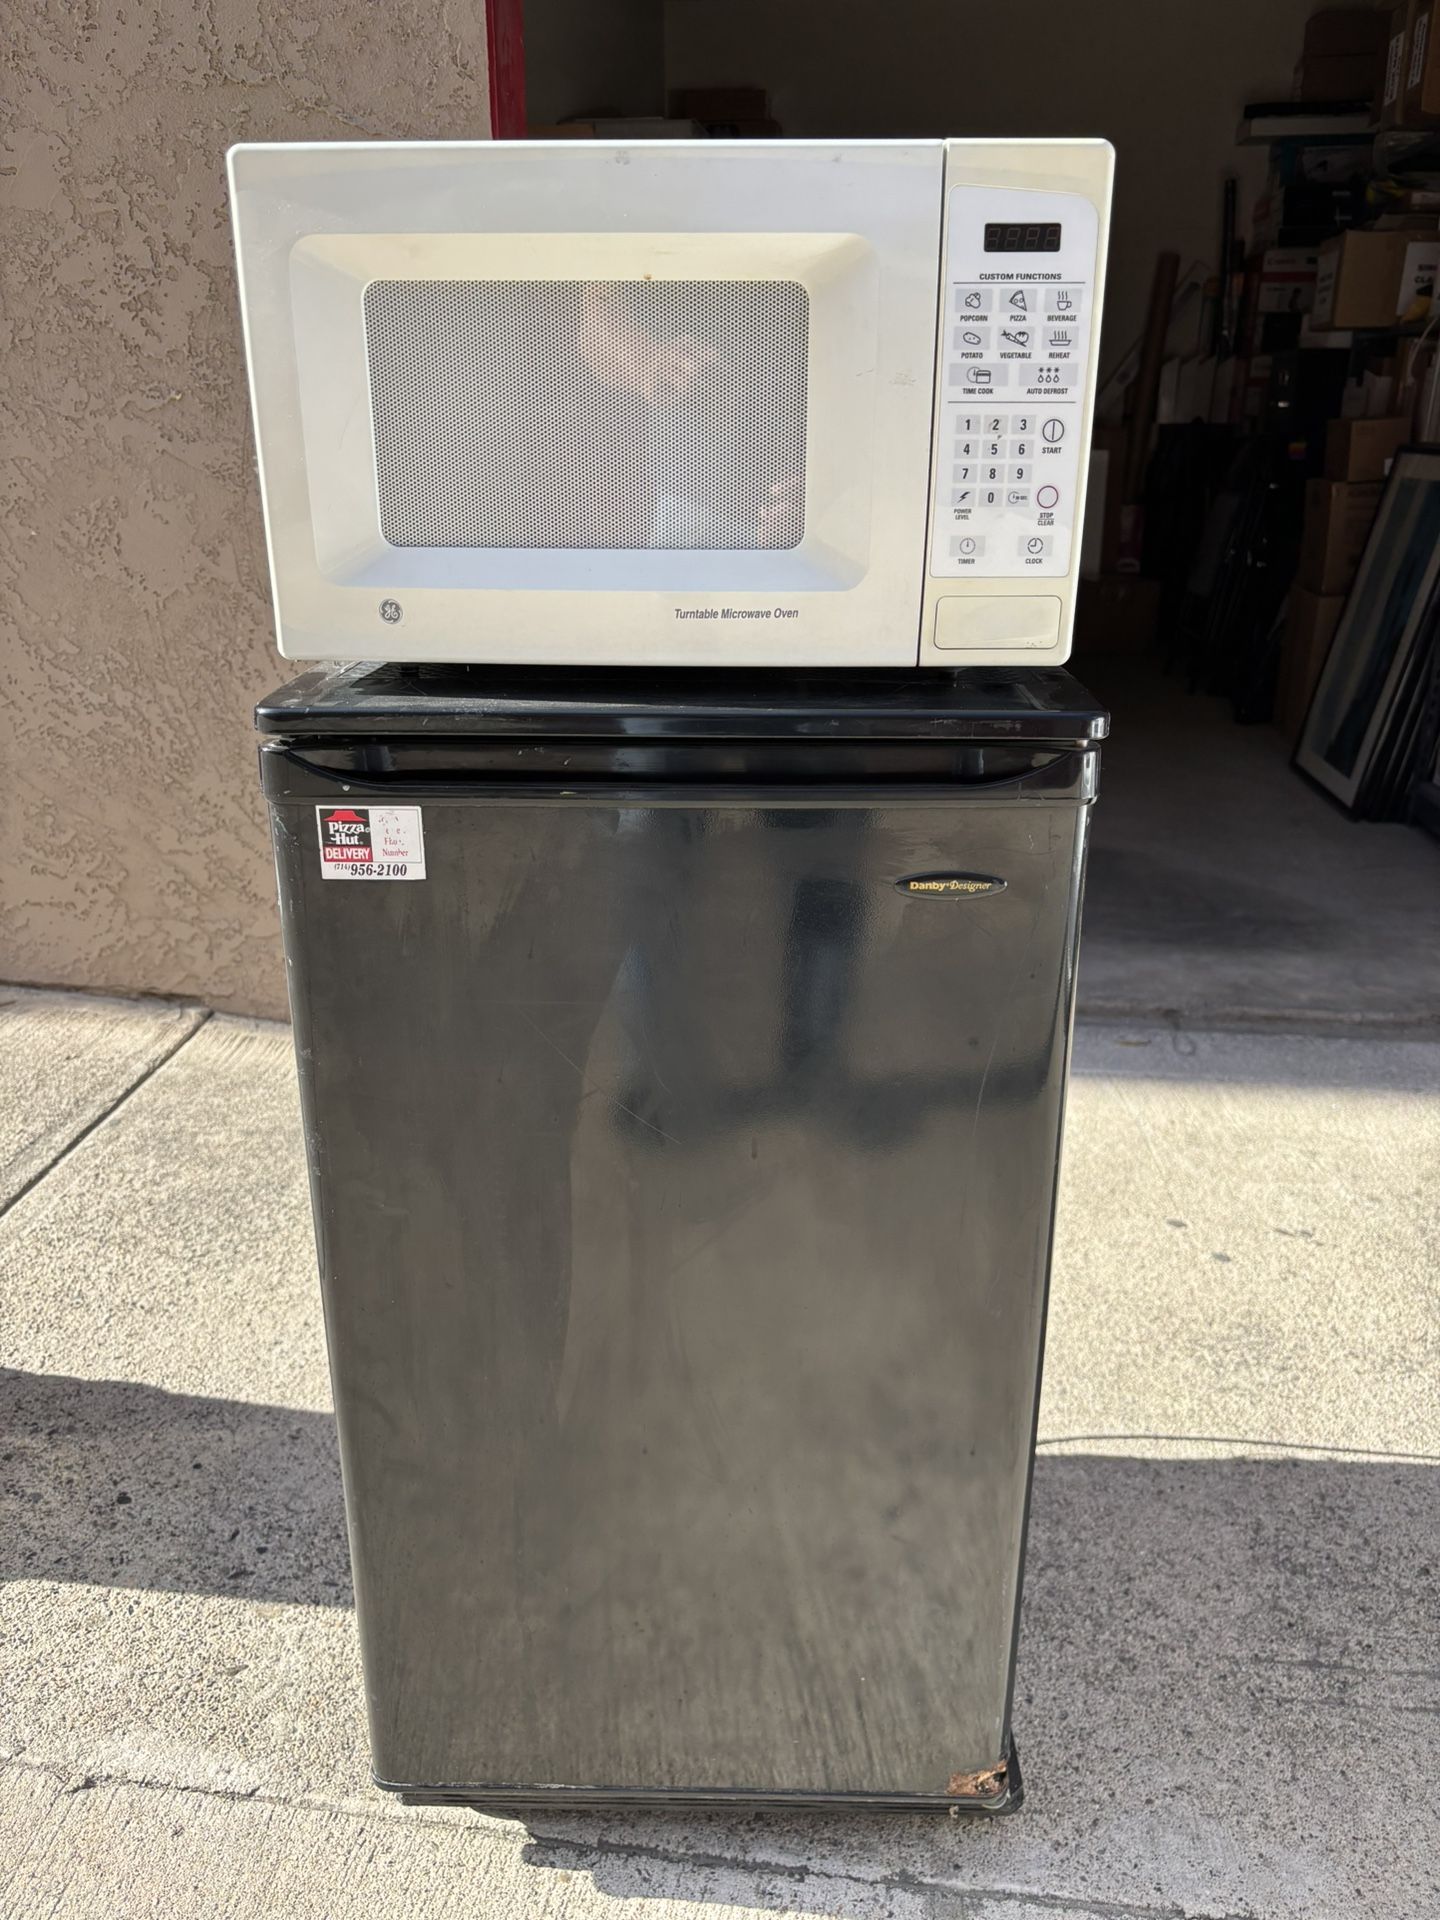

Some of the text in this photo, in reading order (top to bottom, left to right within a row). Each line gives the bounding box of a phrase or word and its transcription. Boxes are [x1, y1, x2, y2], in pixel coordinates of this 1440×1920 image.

[966, 419, 971, 430] 1
[992, 419, 999, 430] 2
[1020, 419, 1026, 430] 3
[963, 444, 970, 455] 4
[991, 444, 998, 455] 5
[1018, 444, 1025, 455] 6
[962, 468, 968, 479] 7
[989, 468, 995, 479] 8
[1017, 468, 1023, 479] 9
[988, 492, 994, 503] 0
[675, 608, 798, 619] Turntable Microwave Oven
[329, 821, 364, 834] Pizza
[330, 833, 359, 845] Hut
[325, 848, 370, 859] DELIVERY
[382, 849, 408, 857] Number
[351, 864, 407, 876] 956-2100
[910, 880, 992, 892] Danby Designer
